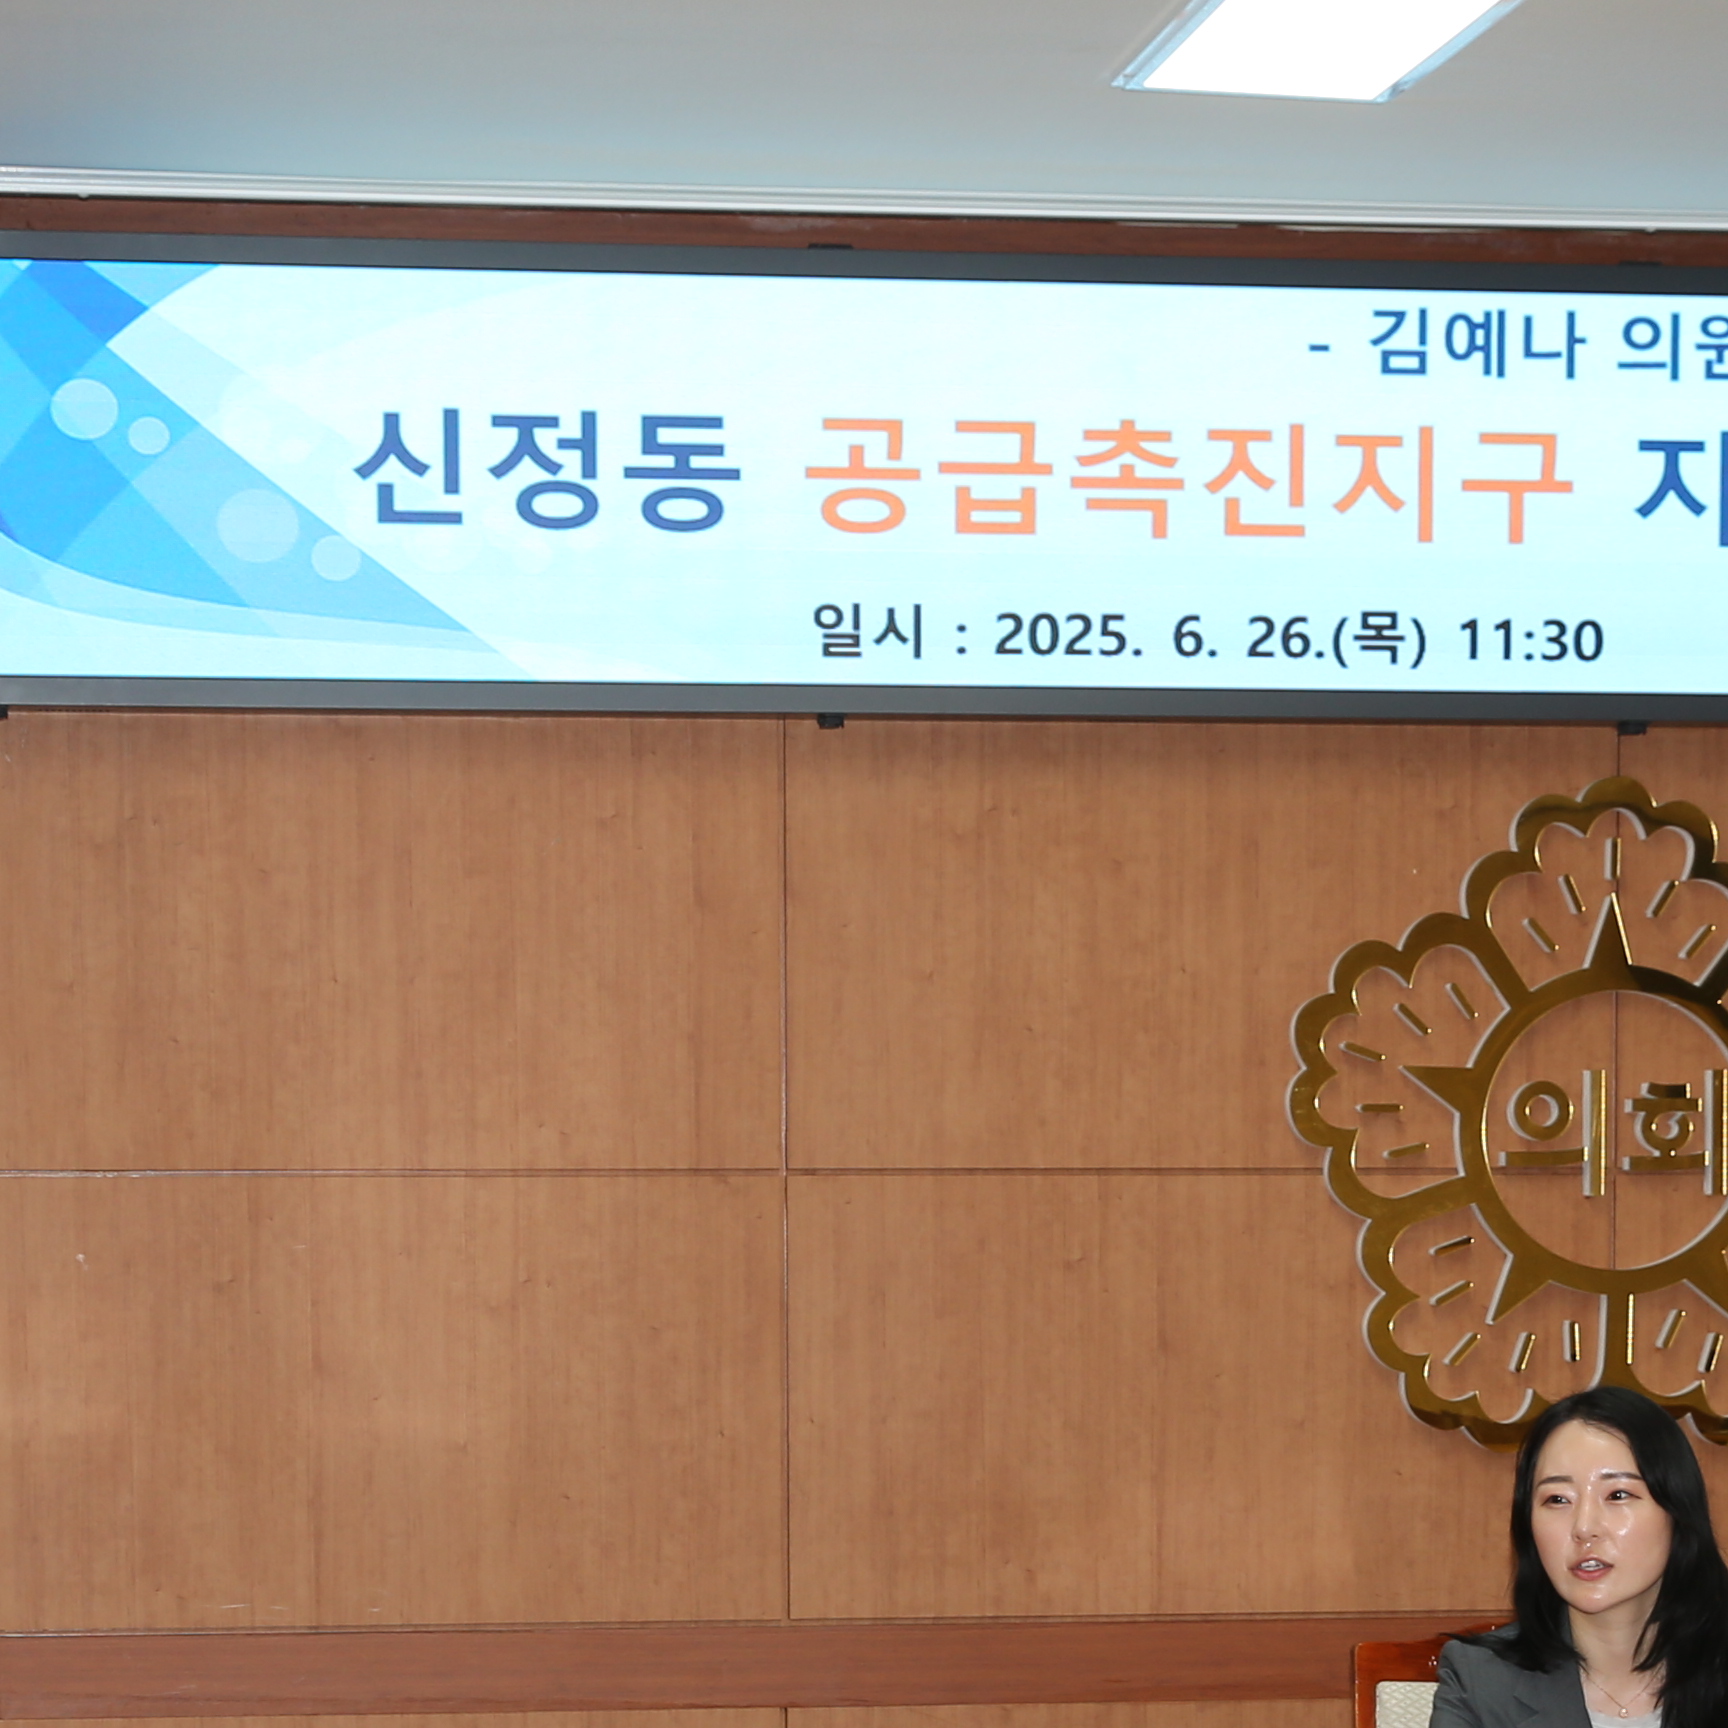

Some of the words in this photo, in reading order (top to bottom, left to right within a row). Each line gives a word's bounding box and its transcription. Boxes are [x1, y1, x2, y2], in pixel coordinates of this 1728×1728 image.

[1369, 306, 1590, 383] 김예나
[354, 408, 743, 535] 신정동
[806, 418, 1575, 546] 공급촉진지구
[813, 602, 924, 662] 일시
[994, 612, 1145, 659] 2025.
[1173, 614, 1220, 661] 6.
[1246, 610, 1429, 672] 26.(목)
[1460, 617, 1606, 665] 11:30
[1497, 1068, 1728, 1197] 의회
